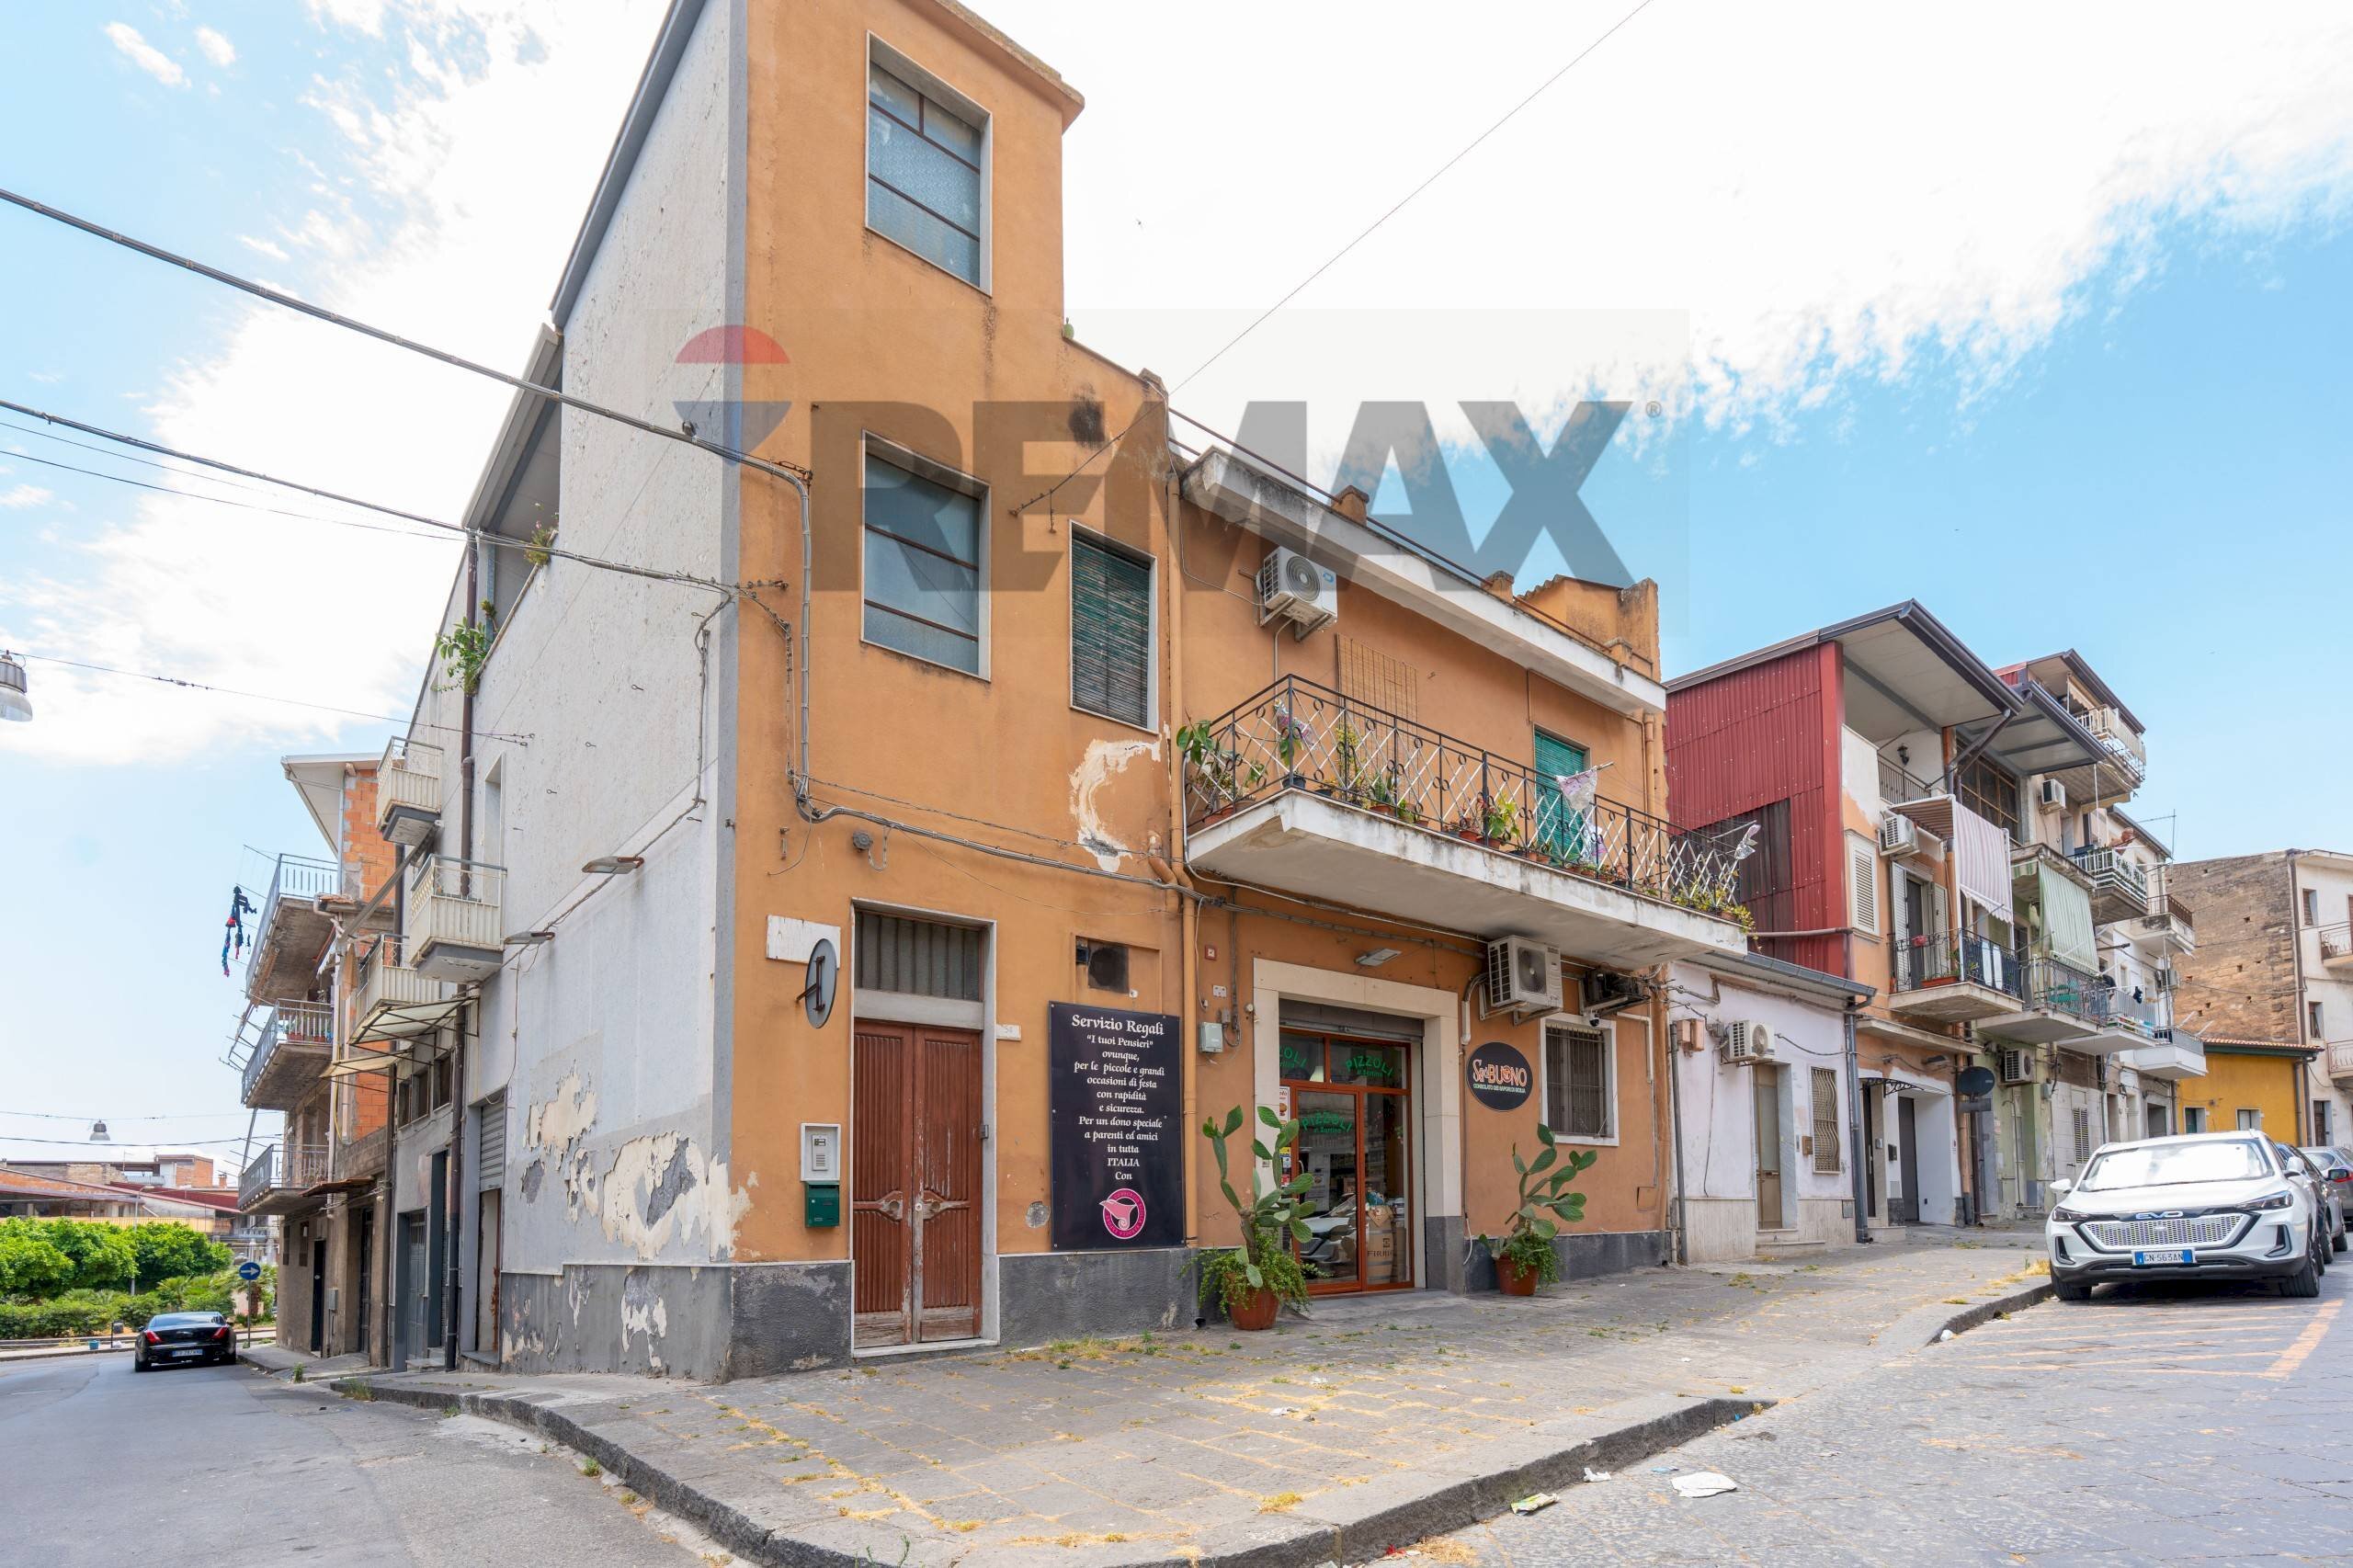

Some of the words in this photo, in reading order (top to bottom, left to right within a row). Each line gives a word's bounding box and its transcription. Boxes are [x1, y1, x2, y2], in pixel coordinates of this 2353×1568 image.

[1072, 1015, 1122, 1030] Servizio
[1126, 1020, 1165, 1038] Regali
[1098, 1036, 1116, 1044] tuoi
[1102, 1051, 1140, 1062] ovunque,
[1074, 1062, 1088, 1073] per
[1091, 1061, 1098, 1070] le
[1103, 1063, 1131, 1074] piccole
[1140, 1067, 1165, 1077] grandi
[1346, 1054, 1393, 1077] PIZZOLI
[1087, 1077, 1126, 1086] occasioni
[1129, 1077, 1136, 1086] di
[1137, 1078, 1157, 1090] festa
[1115, 1091, 1146, 1102] rapidità
[1106, 1104, 1144, 1113] sicurezza.
[1078, 1116, 1094, 1125] Per
[1110, 1117, 1131, 1126] dono
[1133, 1119, 1162, 1130] speciale
[1302, 1110, 1352, 1133] PIZZOLI
[1093, 1131, 1123, 1142] parenti
[1126, 1131, 1135, 1140] ed
[1137, 1132, 1158, 1141] amici
[1108, 1144, 1117, 1153] in
[1119, 1144, 1140, 1153] tutta
[1108, 1158, 1140, 1166] ITALIA
